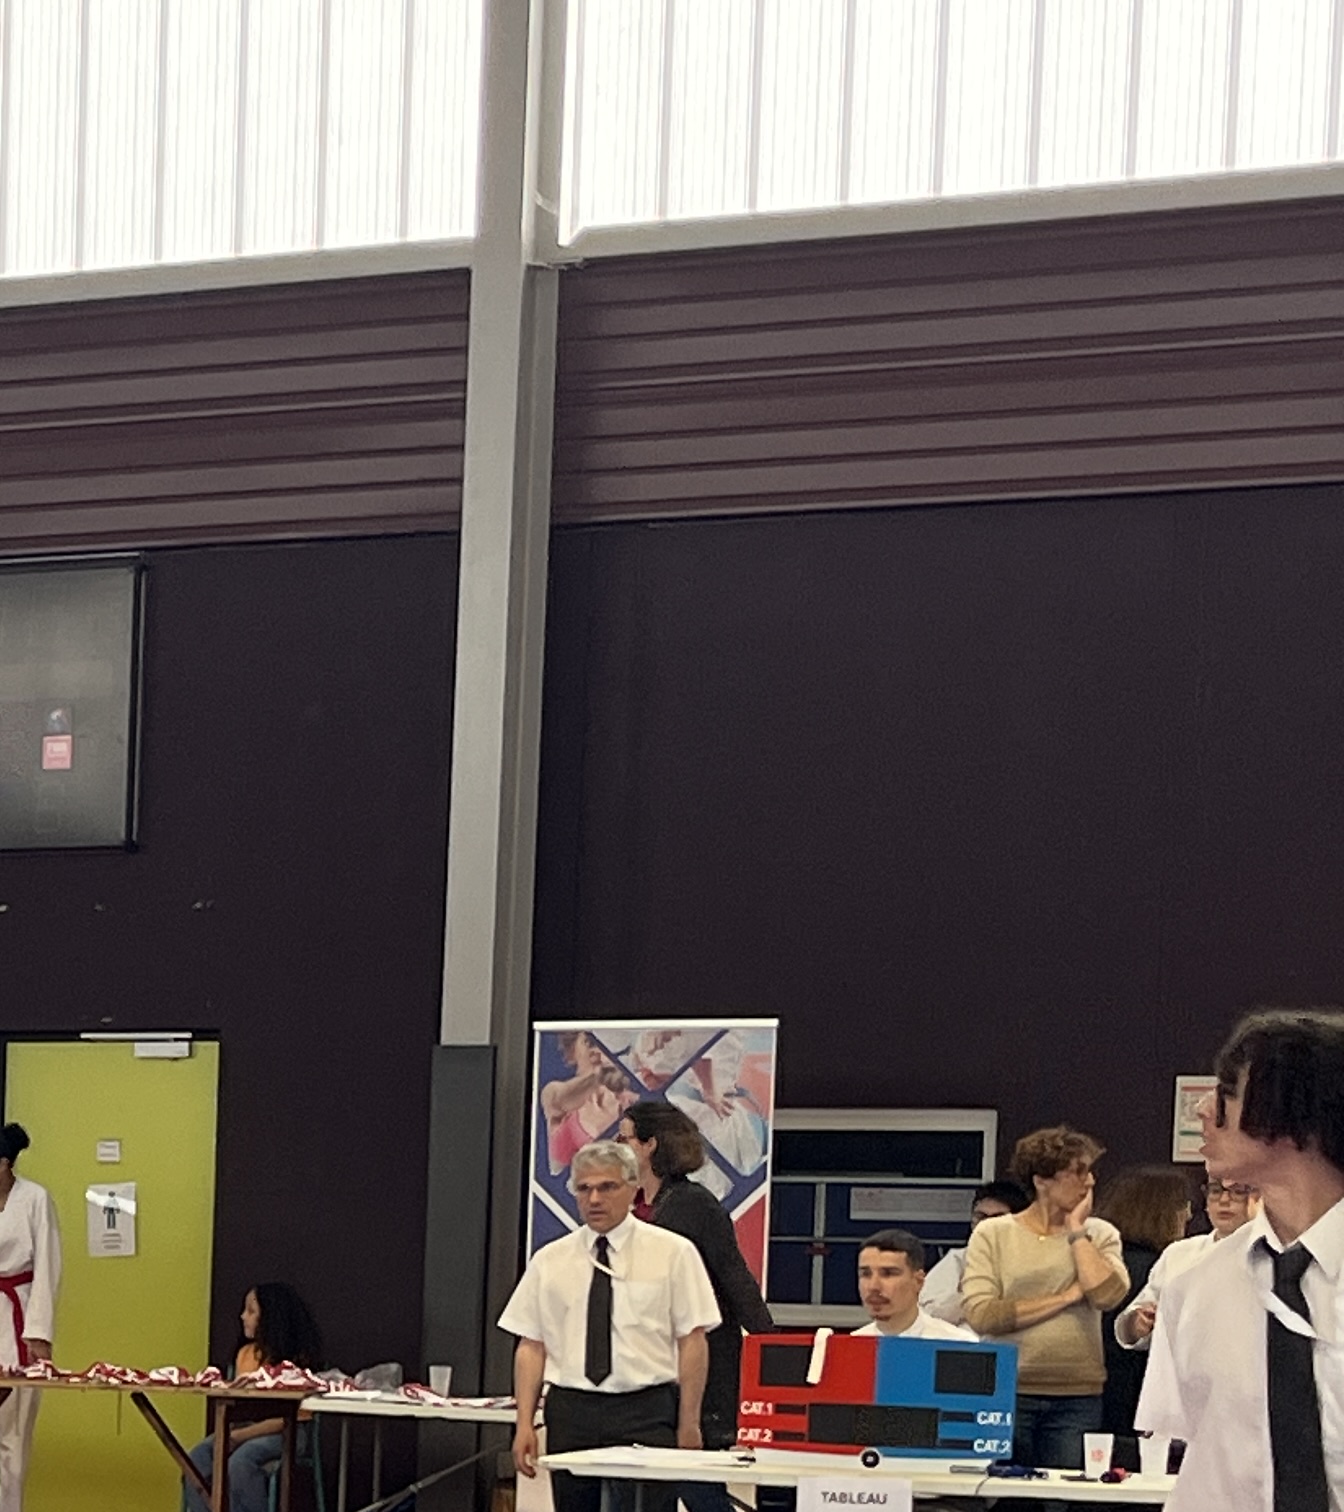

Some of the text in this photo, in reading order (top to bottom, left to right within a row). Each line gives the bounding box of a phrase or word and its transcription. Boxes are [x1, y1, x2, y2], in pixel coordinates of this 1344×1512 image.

[740, 1400, 773, 1416] CAT.1
[737, 1427, 772, 1443] CAT.2
[821, 1491, 888, 1505] TABLEAU
